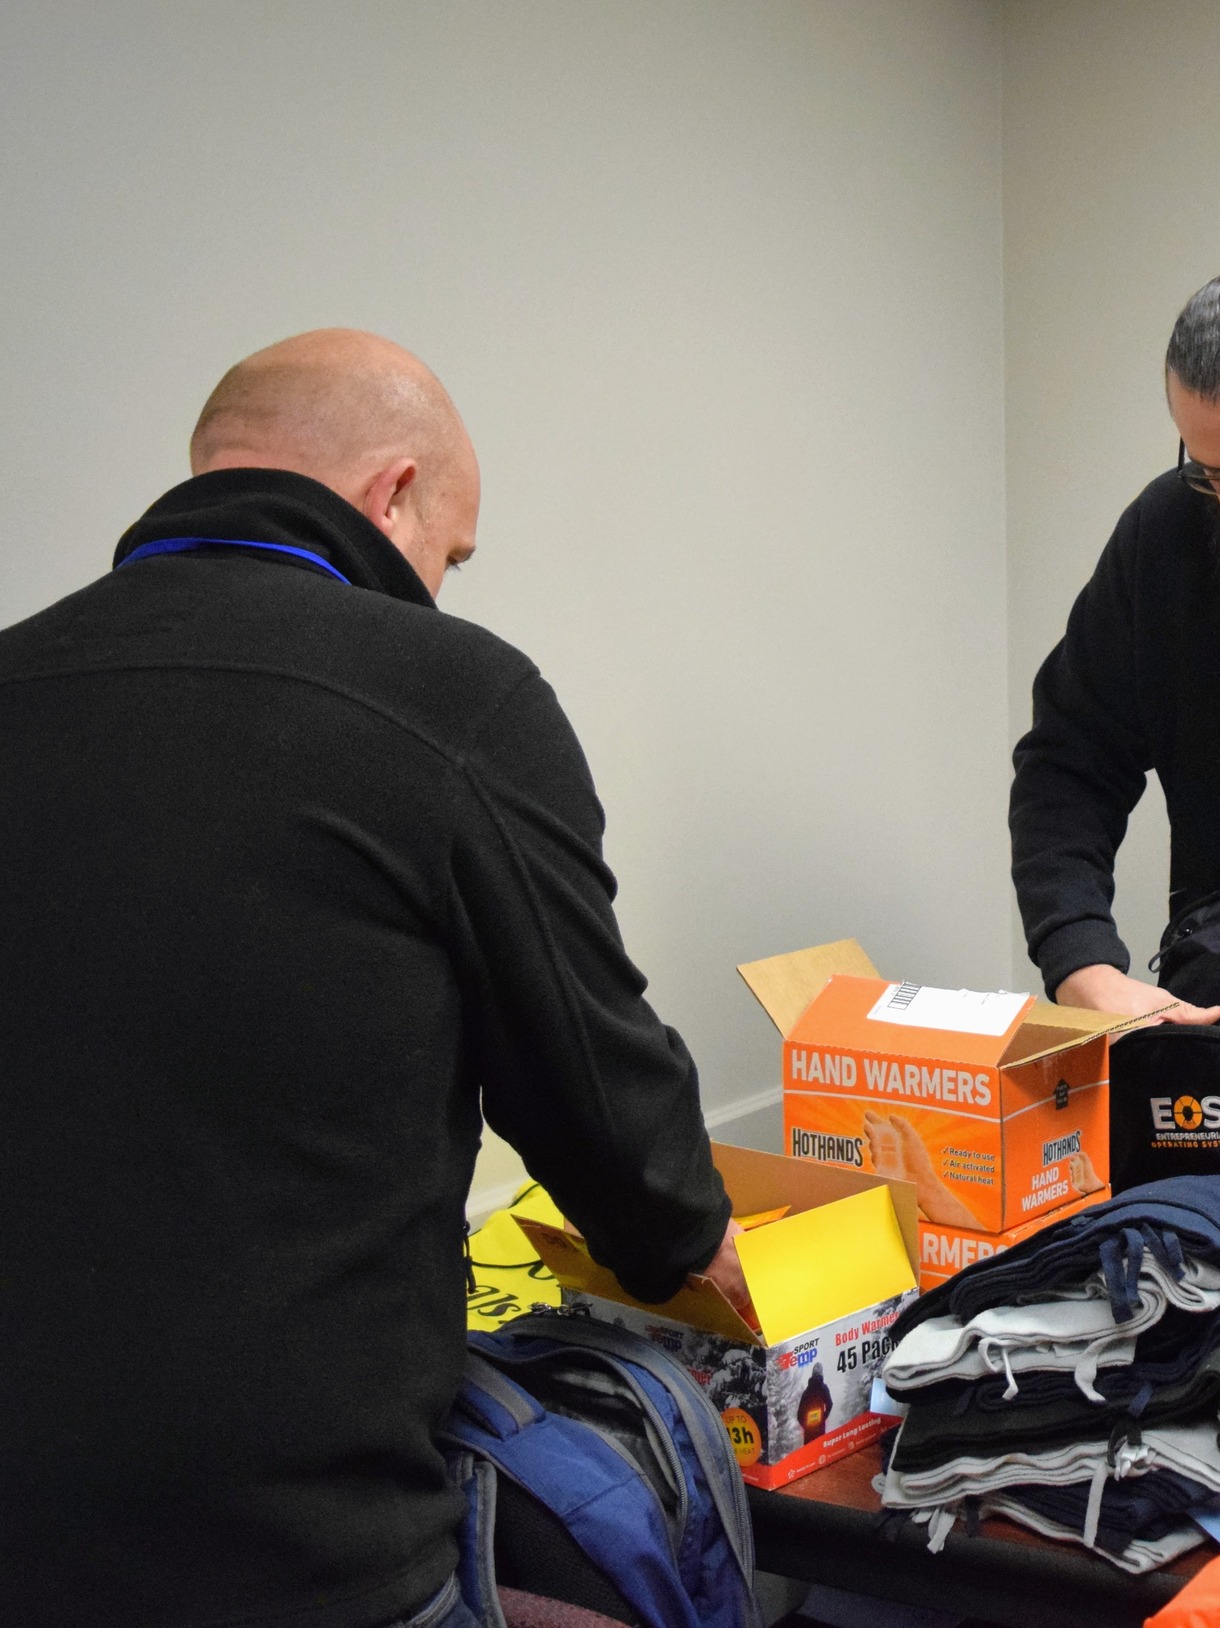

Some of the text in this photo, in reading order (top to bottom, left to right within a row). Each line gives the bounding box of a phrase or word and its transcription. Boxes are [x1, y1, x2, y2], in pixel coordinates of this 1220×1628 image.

[792, 1049, 992, 1106] HAND WARMERS
[792, 1127, 863, 1167] HOTHANDS
[949, 1147, 972, 1159] Ready
[973, 1151, 981, 1159] to
[1043, 1130, 1081, 1166] HOTHANDS
[1151, 1140, 1199, 1149] OPERATING
[949, 1160, 995, 1173] Air activated
[949, 1171, 994, 1185] Natural heat
[1032, 1167, 1059, 1191] HAND
[1022, 1180, 1069, 1212] WARMERS
[793, 1337, 820, 1355] SPORT
[835, 1327, 860, 1347] Body
[837, 1345, 857, 1373] 45
[823, 1436, 842, 1448] Super
[842, 1427, 858, 1440] Long
[858, 1417, 881, 1432] Lasting
